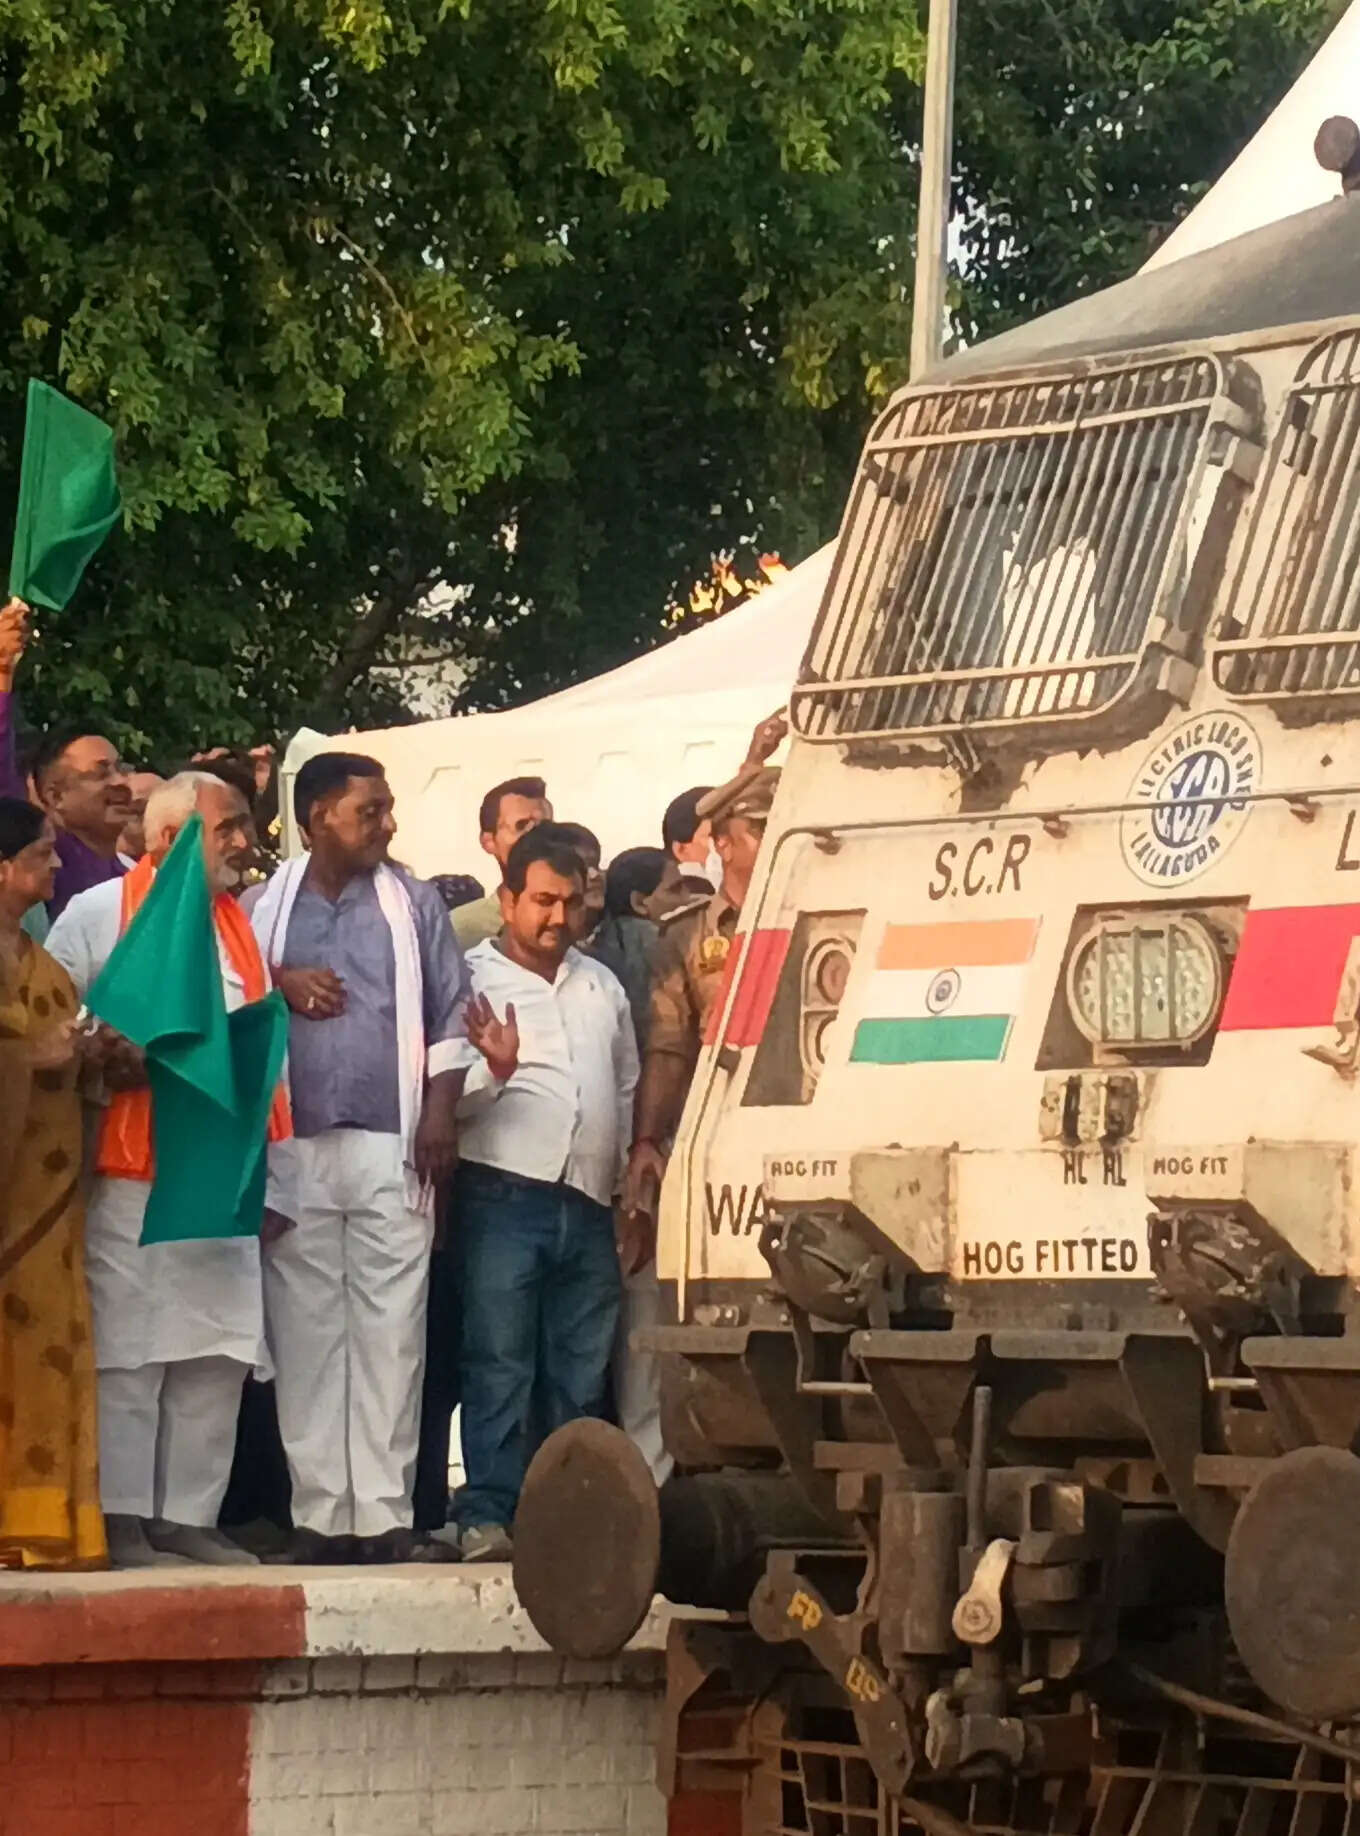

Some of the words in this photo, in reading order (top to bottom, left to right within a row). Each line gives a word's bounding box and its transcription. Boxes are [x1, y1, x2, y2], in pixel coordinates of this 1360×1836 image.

[1133, 723, 1205, 804] LECTRIC
[1207, 720, 1248, 756] LOCO
[928, 834, 1032, 901] S.C.R
[1130, 831, 1221, 877] LALLAGUDA
[812, 1159, 838, 1177] FIT
[1153, 1156, 1194, 1175] HOG
[1199, 1156, 1229, 1175] FIT
[963, 1240, 1025, 1276] HOG
[1035, 1237, 1139, 1273] FITTED
